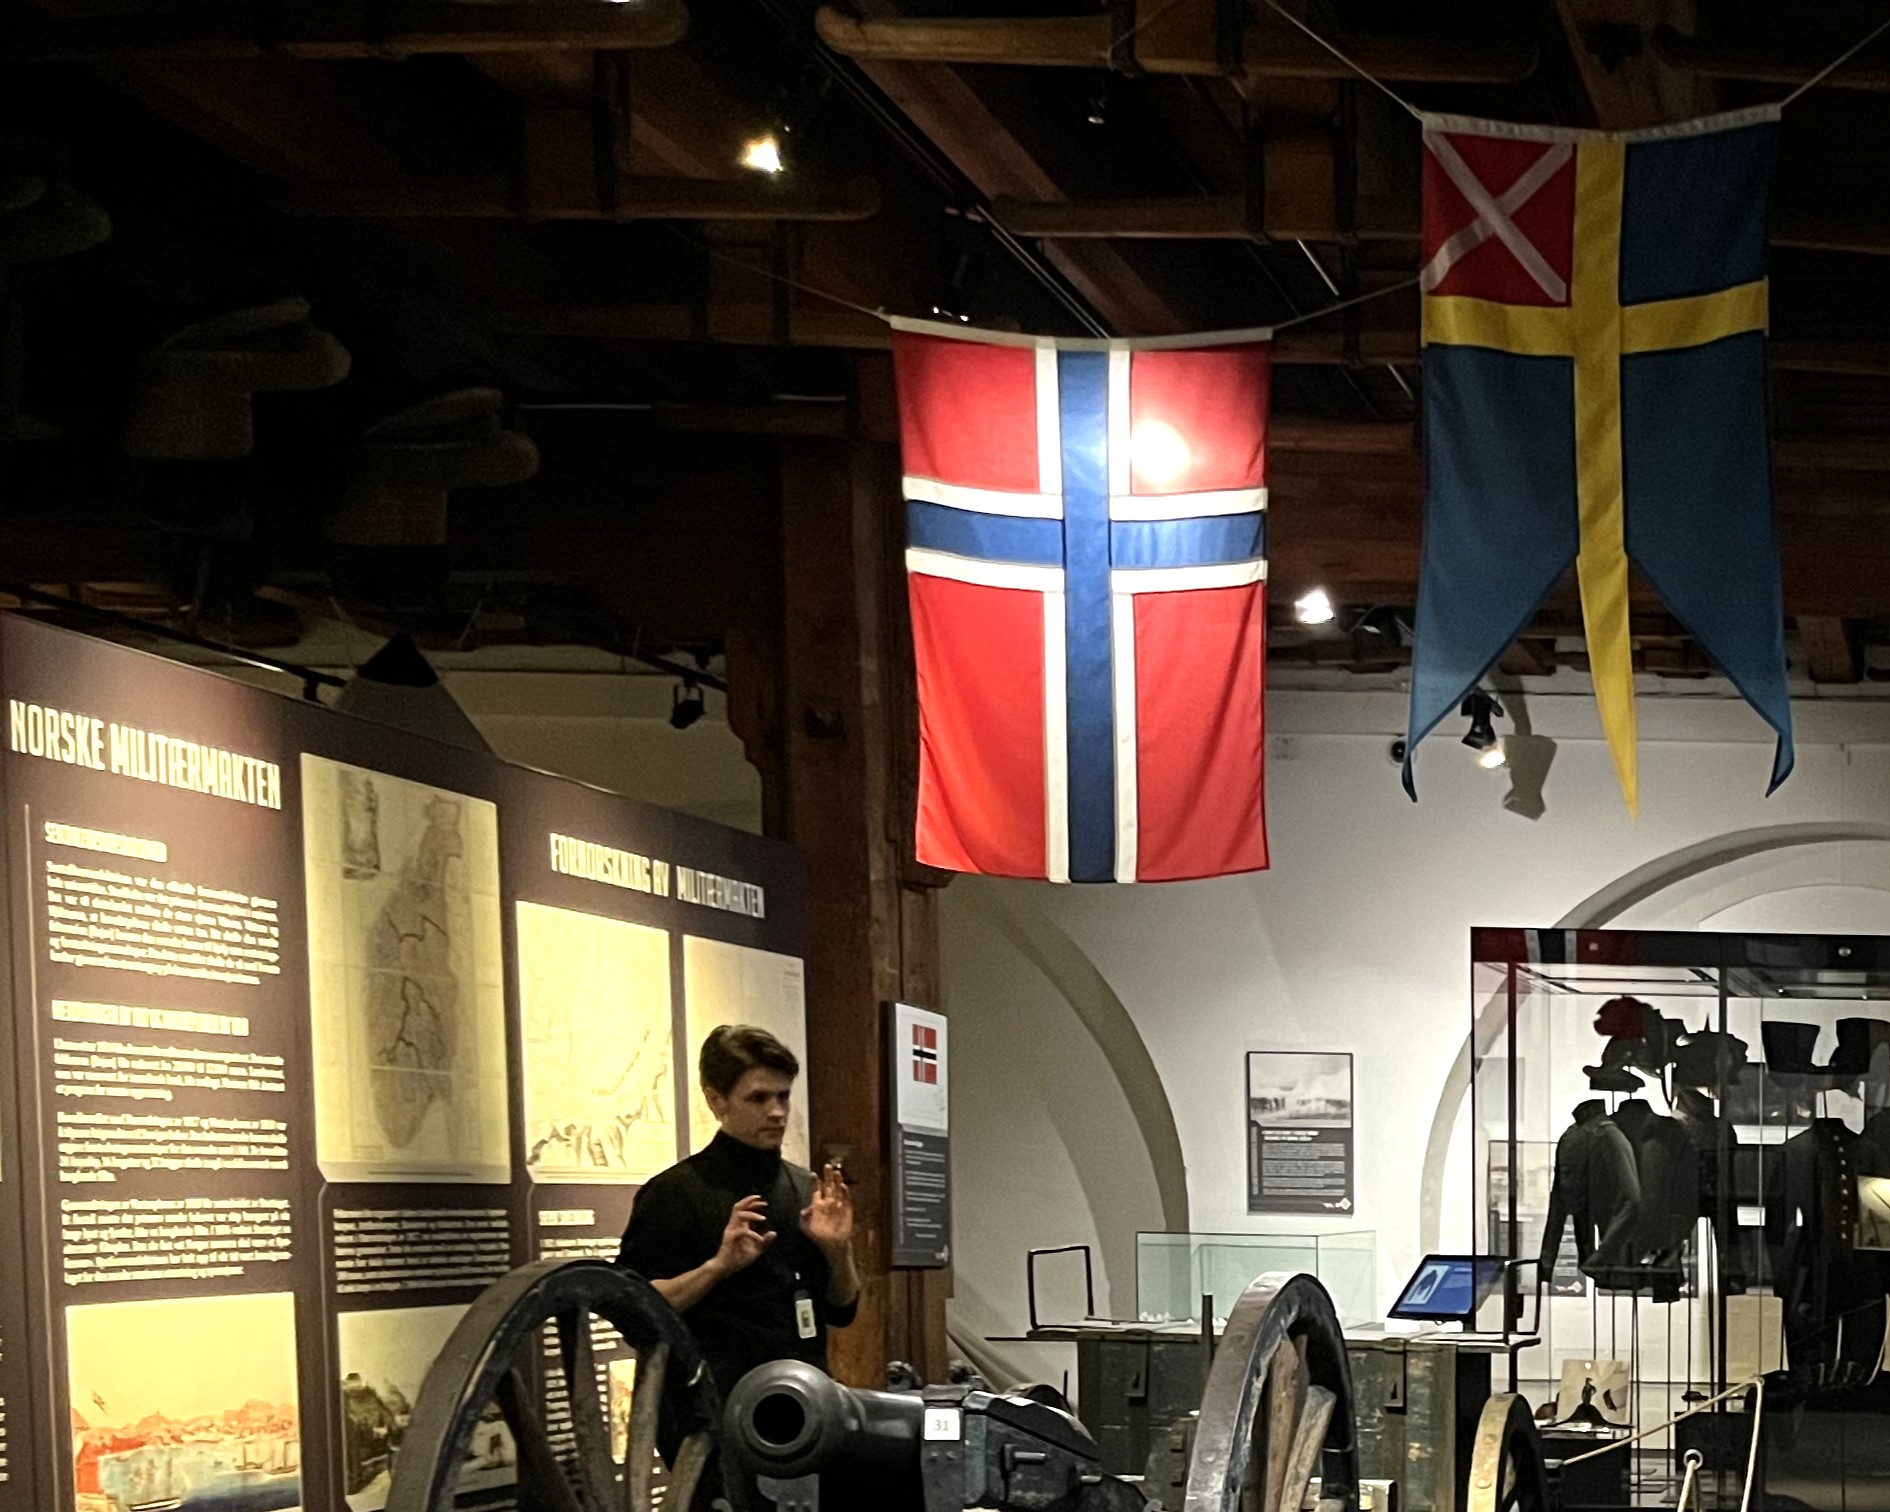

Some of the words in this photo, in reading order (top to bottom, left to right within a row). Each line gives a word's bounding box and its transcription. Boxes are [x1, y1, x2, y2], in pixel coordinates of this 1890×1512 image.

[10, 699, 105, 771] NORSKE
[109, 722, 281, 810] MILITÆRMAKTEN
[934, 1419, 949, 1432] 31
